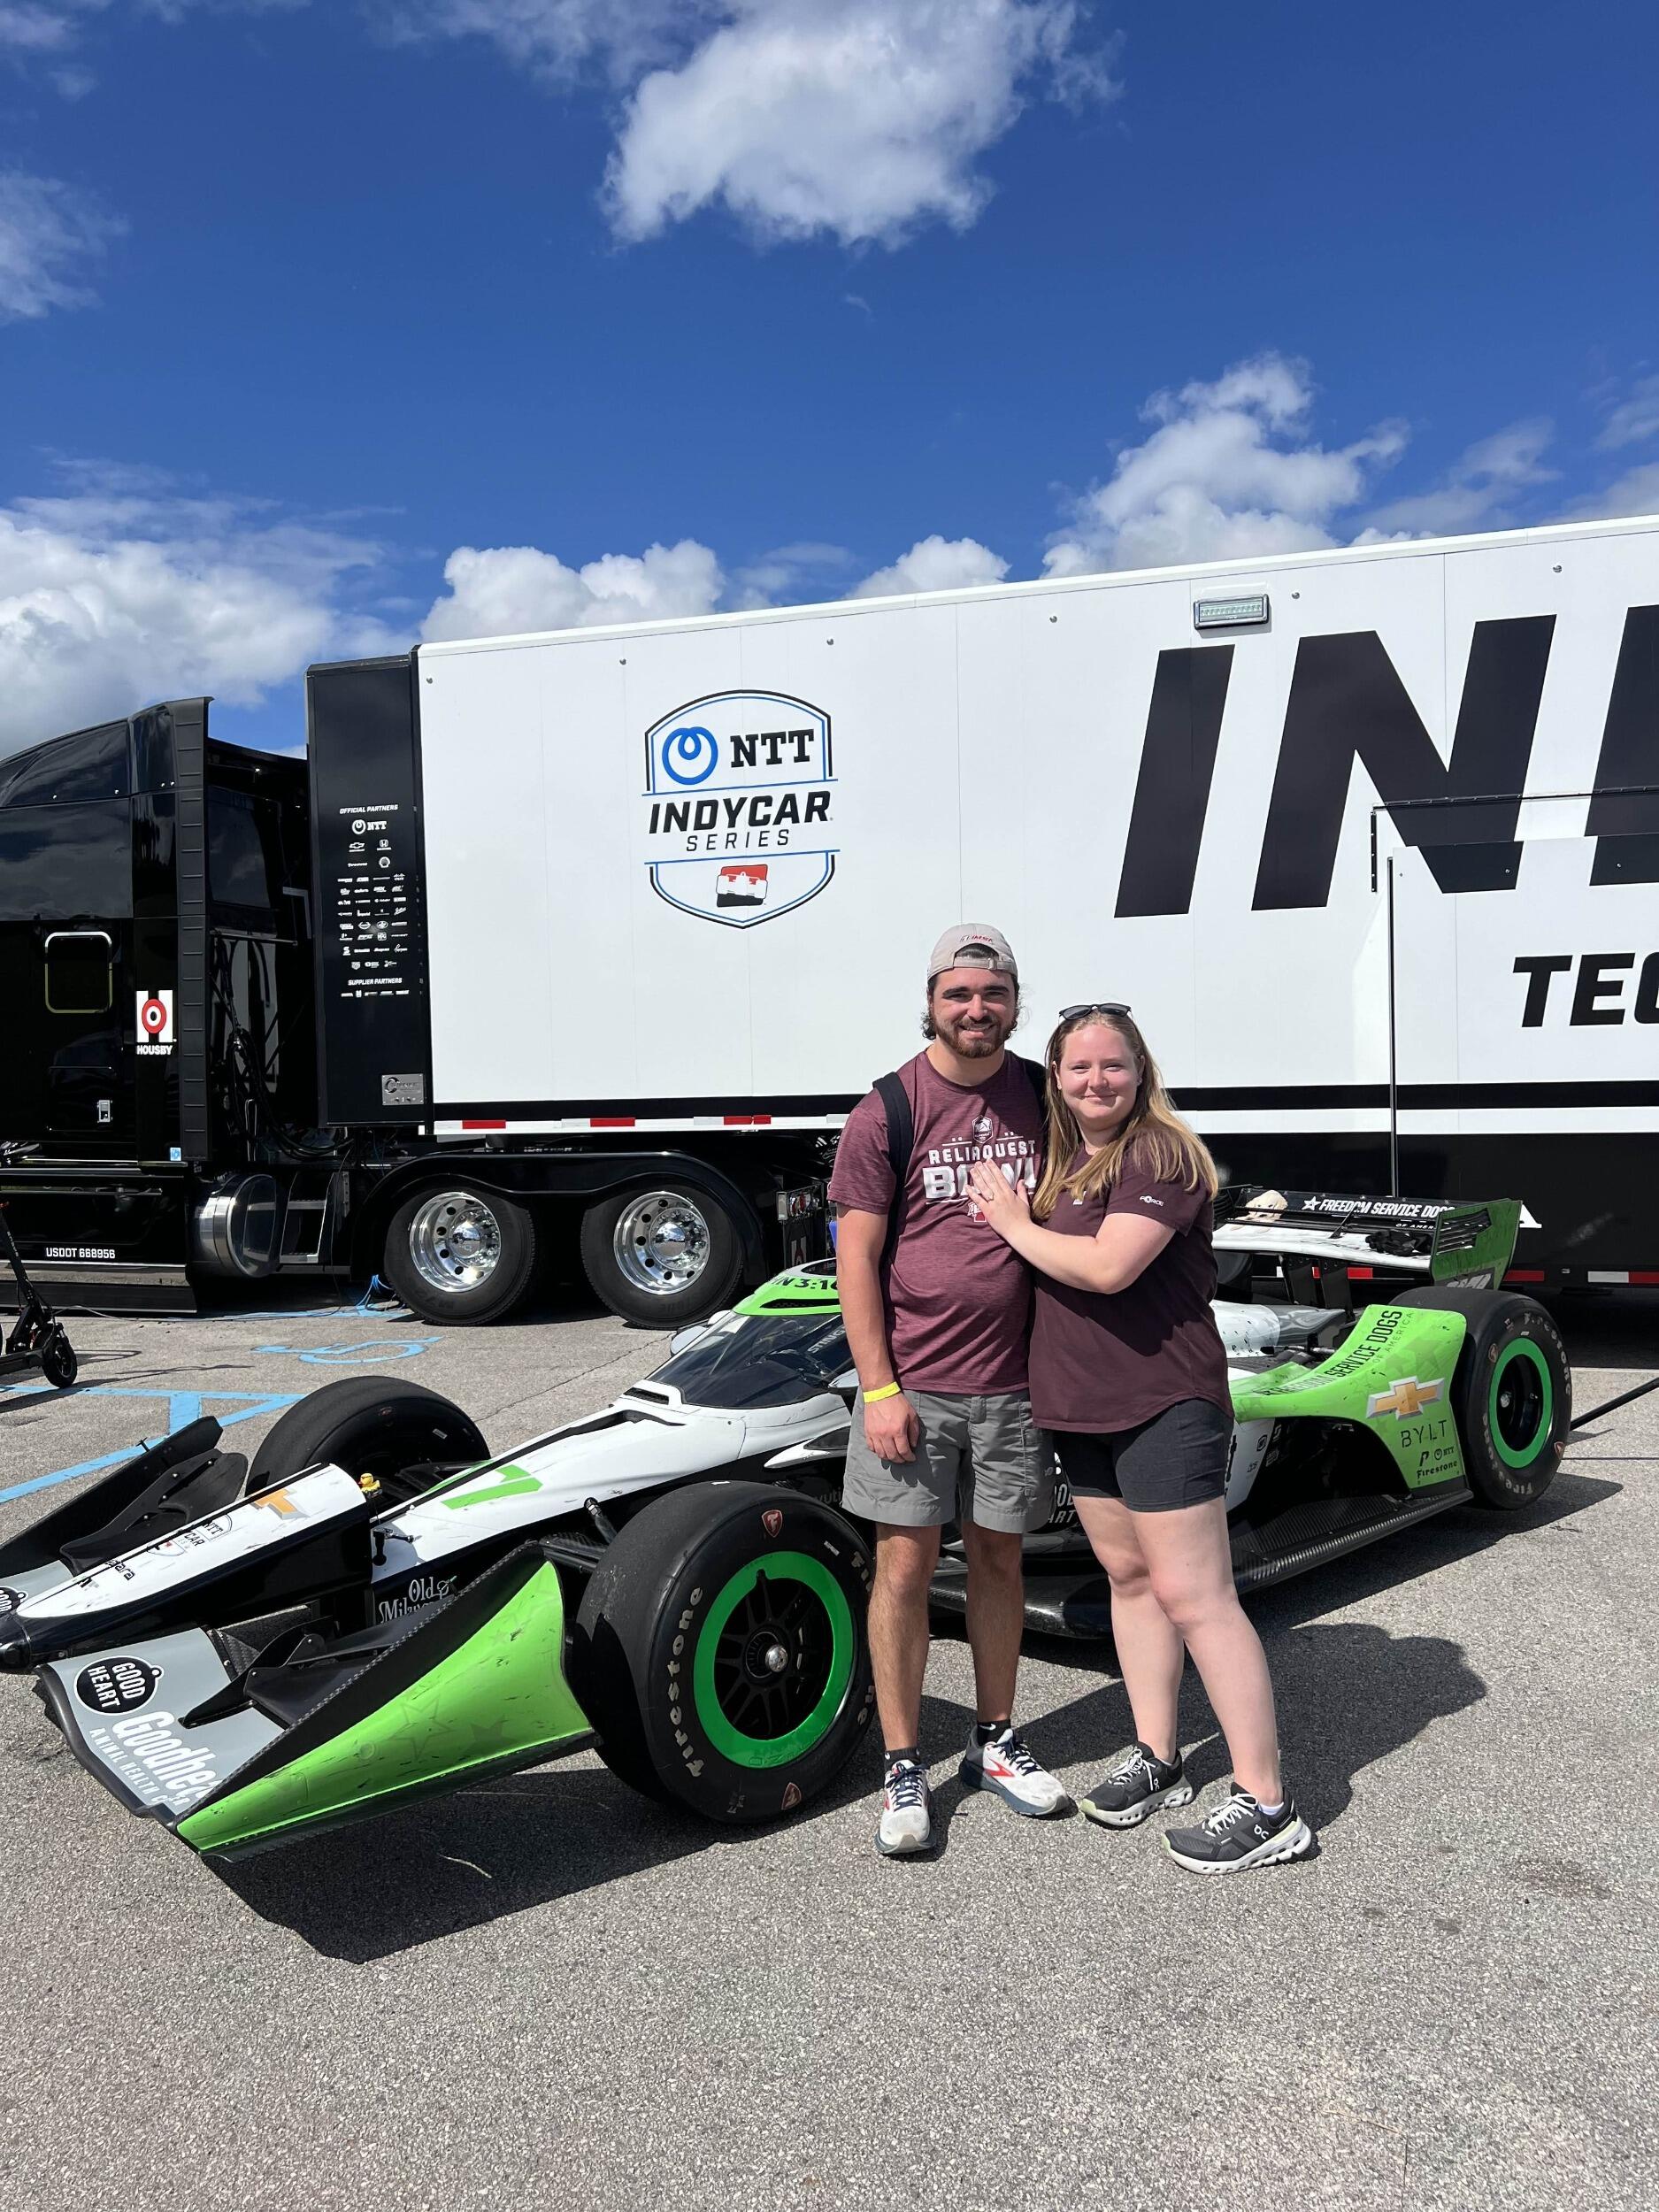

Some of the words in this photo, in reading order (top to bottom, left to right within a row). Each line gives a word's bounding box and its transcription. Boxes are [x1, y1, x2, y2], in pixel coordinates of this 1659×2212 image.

[730, 728, 814, 768] NTT
[367, 821, 387, 830] NTT
[649, 790, 831, 833] INDYCAR
[686, 829, 789, 852] SERIES
[136, 1045, 173, 1055] HOUSBY
[928, 1140, 1035, 1165] RELIAQUEST
[1318, 1198, 1372, 1214] FREEDOM
[1371, 1202, 1422, 1217] SERVICE
[46, 1247, 77, 1257] USDOT
[79, 1248, 116, 1259] 668956
[1324, 1344, 1381, 1378] SERVICE
[1365, 1310, 1403, 1345] DOGS
[1401, 1419, 1448, 1448] BYLT
[1417, 1460, 1458, 1480] Firestone
[88, 1665, 121, 1708] HEART
[111, 1663, 146, 1699] GOOD
[667, 1586, 705, 1778] Firestone
[88, 1727, 128, 1763] ANIMAL
[119, 1762, 160, 1795] HEALTH
